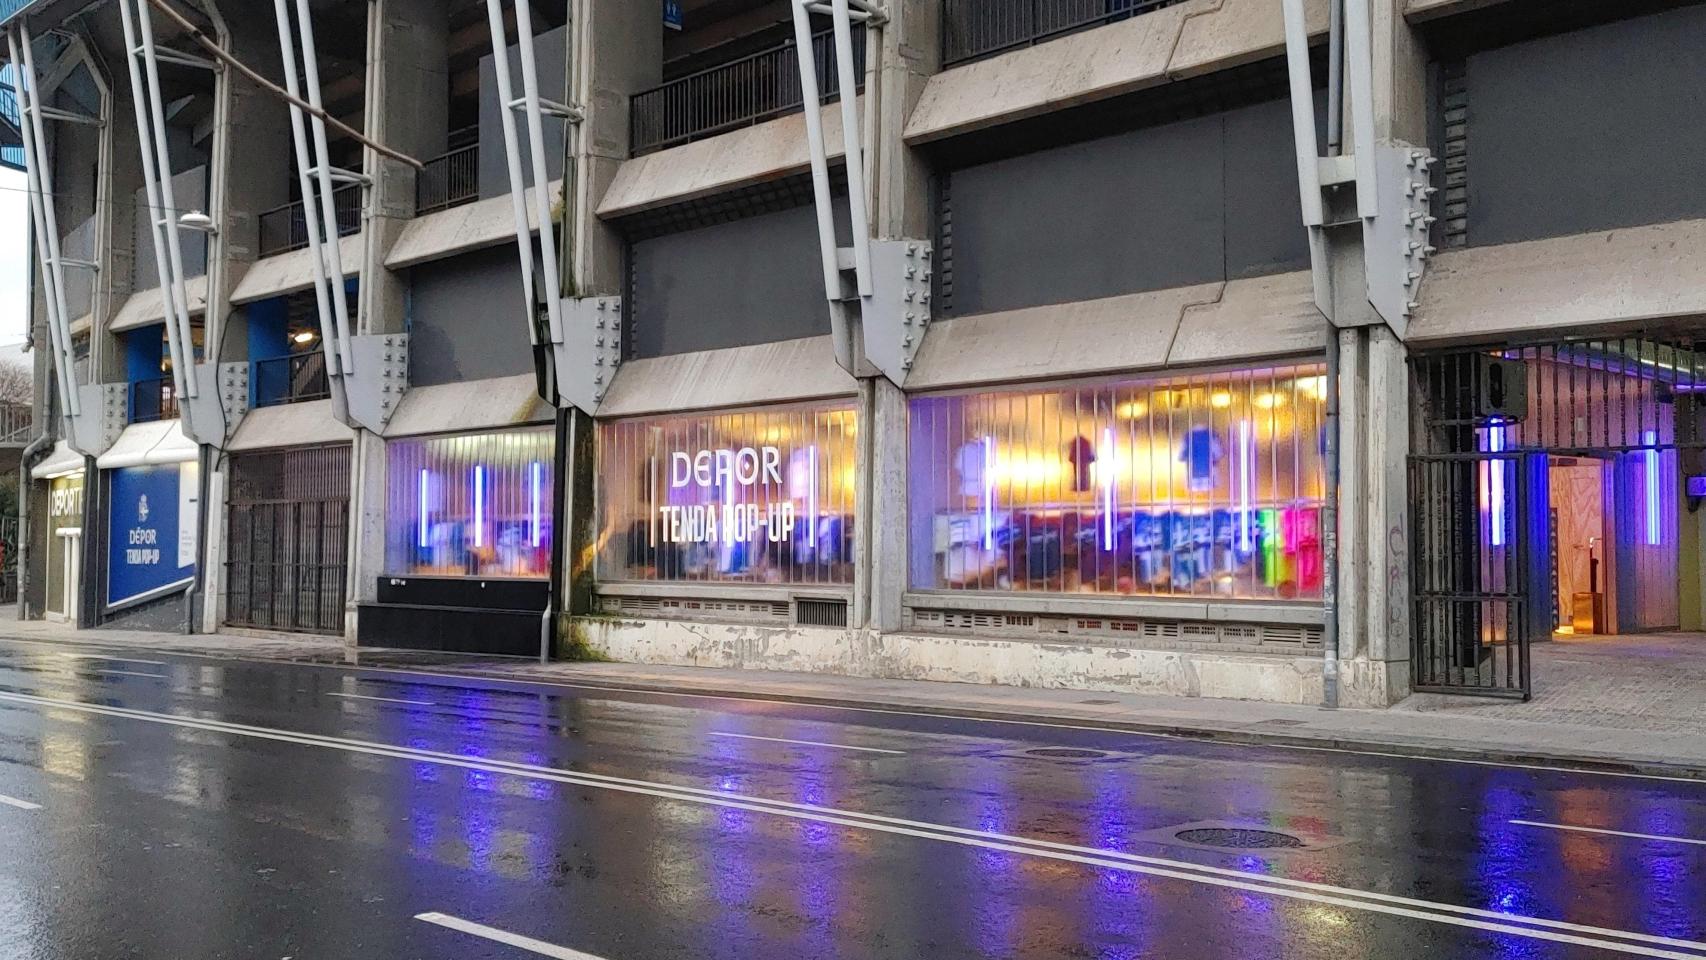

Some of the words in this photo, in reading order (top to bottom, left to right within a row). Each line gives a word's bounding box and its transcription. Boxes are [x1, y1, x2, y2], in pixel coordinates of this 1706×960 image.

[129, 526, 157, 545] DÉPOR
[660, 504, 718, 543] TENDA
[722, 501, 795, 543] POP-UP
